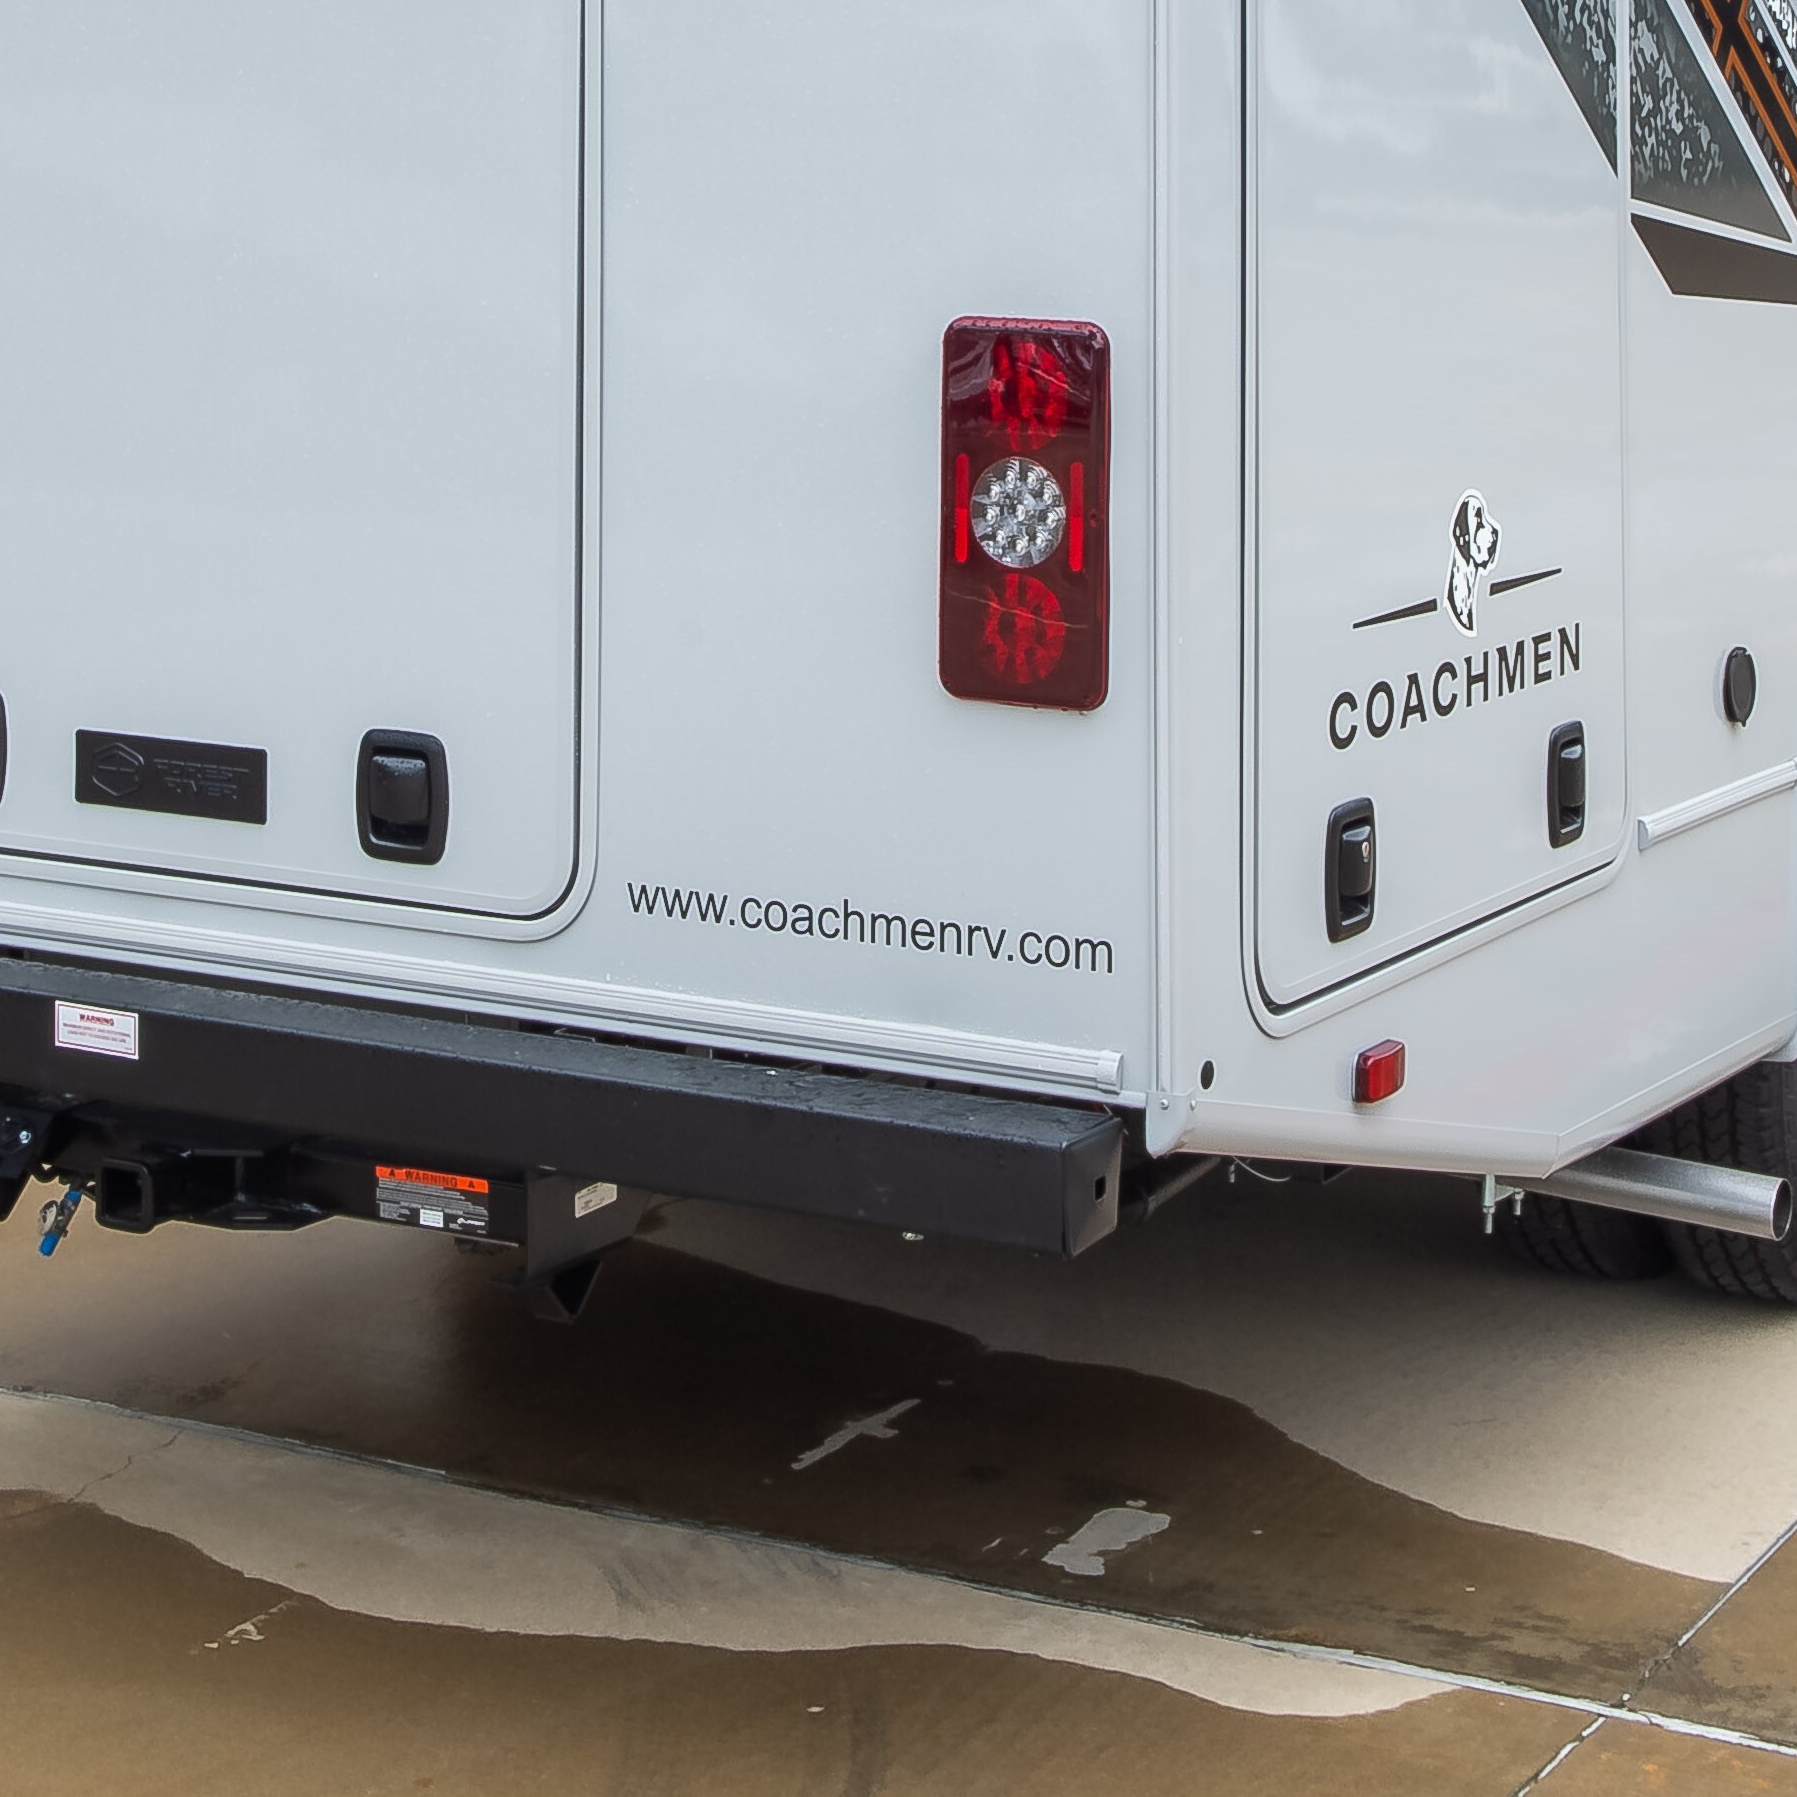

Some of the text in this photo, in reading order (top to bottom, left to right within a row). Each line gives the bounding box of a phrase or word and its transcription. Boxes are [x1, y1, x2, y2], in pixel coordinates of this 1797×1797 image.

[1329, 622, 1581, 750] COACHMEN
[626, 882, 1114, 975] www.coachmenrv.com
[404, 1169, 458, 1188] WARNING
